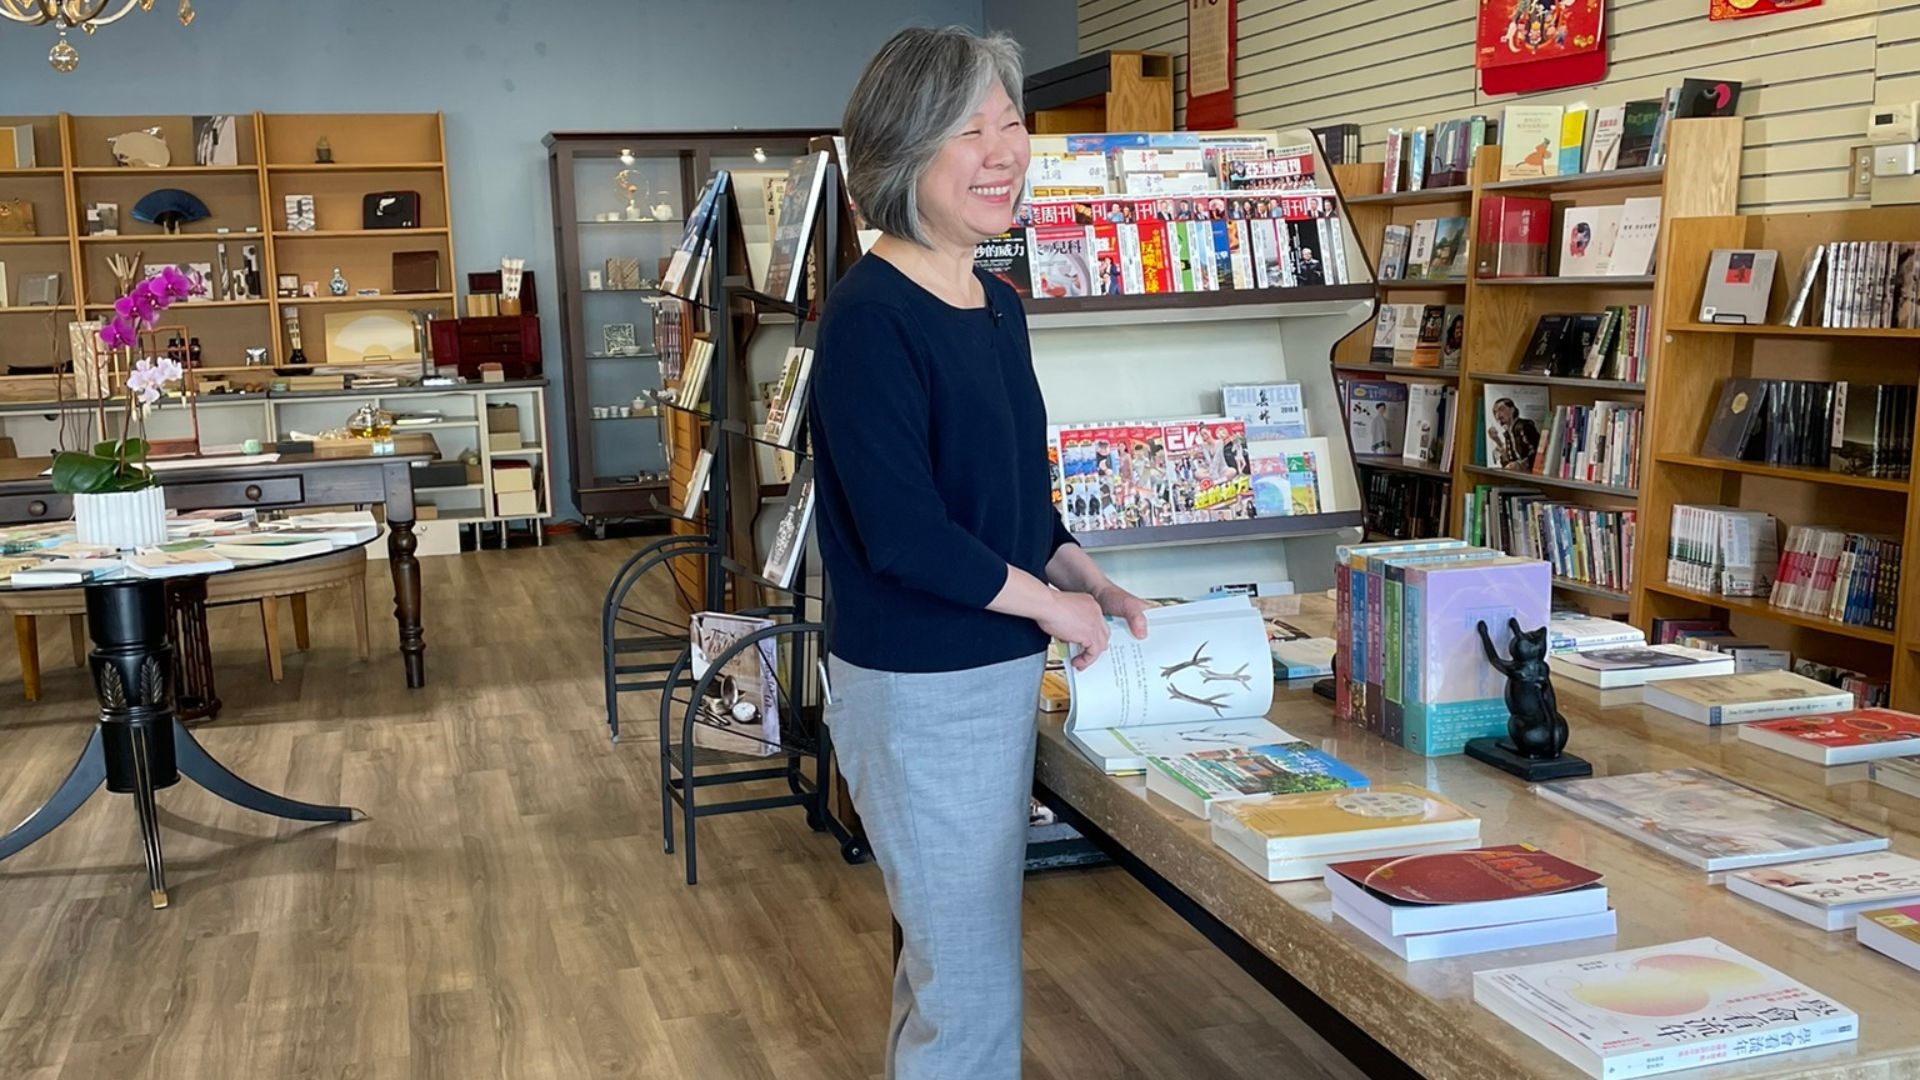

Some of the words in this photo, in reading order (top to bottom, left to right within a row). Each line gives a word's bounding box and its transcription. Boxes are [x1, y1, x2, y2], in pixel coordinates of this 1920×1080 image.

[1135, 202, 1157, 221] 刊
[1655, 999, 1839, 1042] 學會看流年
